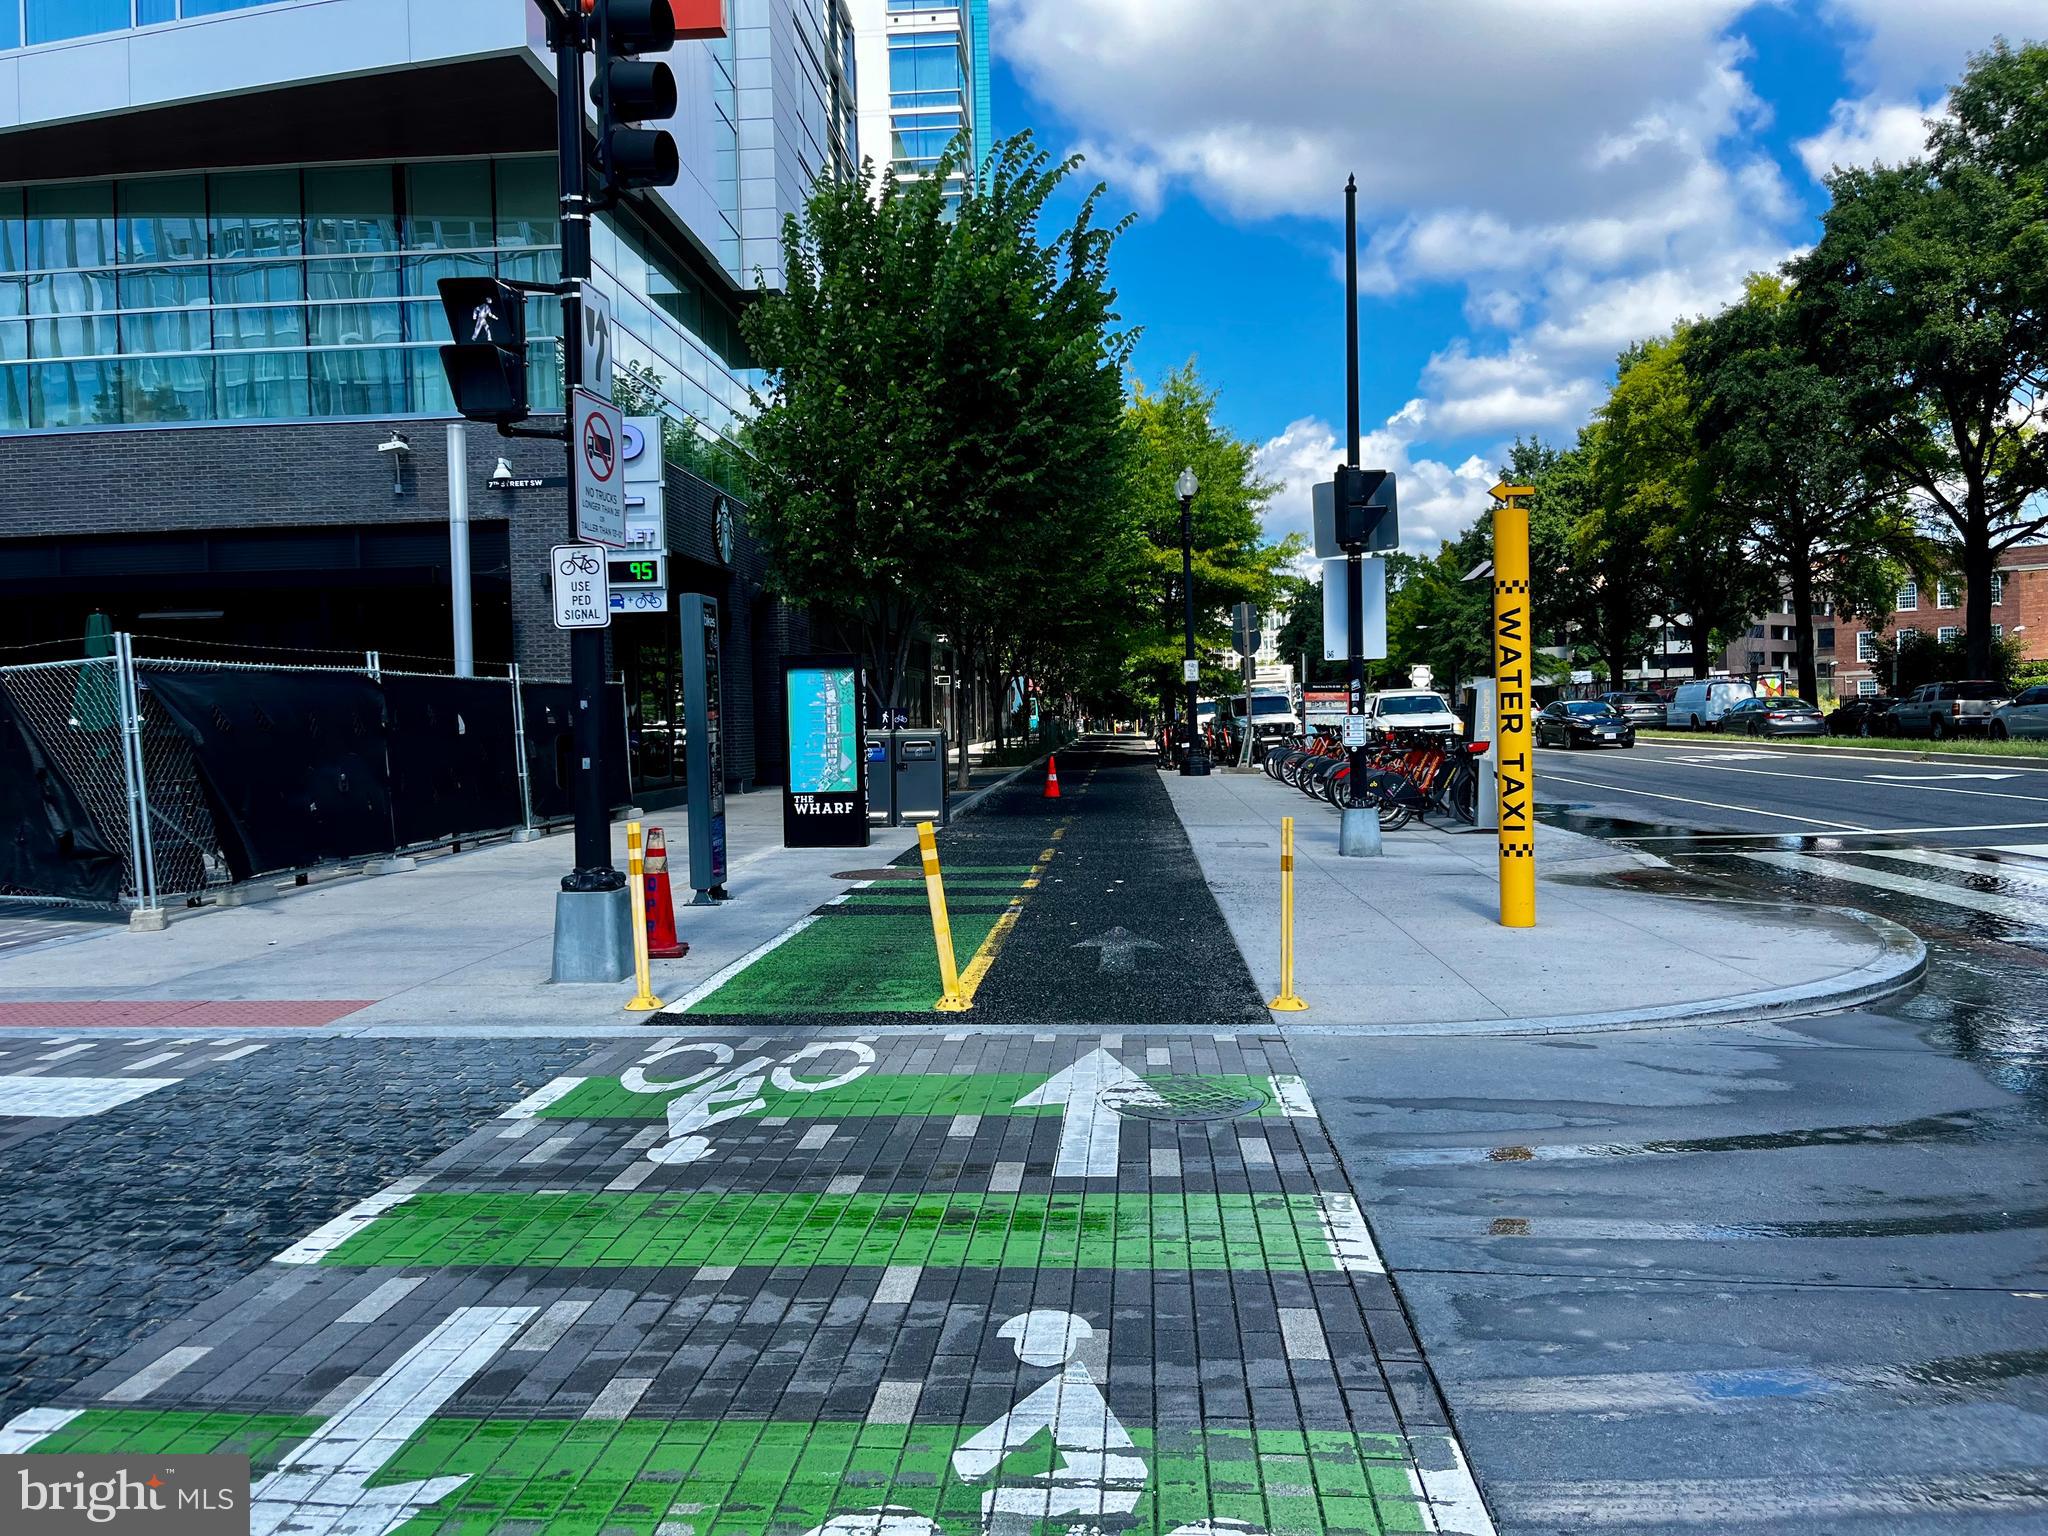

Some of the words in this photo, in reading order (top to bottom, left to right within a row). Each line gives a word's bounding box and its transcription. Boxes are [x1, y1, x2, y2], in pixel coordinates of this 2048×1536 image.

[585, 486, 594, 498] NO
[595, 488, 617, 505] TRUCKS
[626, 529, 655, 543] LET
[629, 562, 653, 580] 95
[571, 581, 591, 592] USE
[572, 595, 591, 606] PED
[564, 608, 600, 621] SIGNAL
[1498, 607, 1524, 734] WATER
[861, 692, 870, 820] INFORMATION
[1501, 752, 1526, 832] TAXI
[794, 795, 815, 804] THE
[794, 802, 854, 815] WHARF
